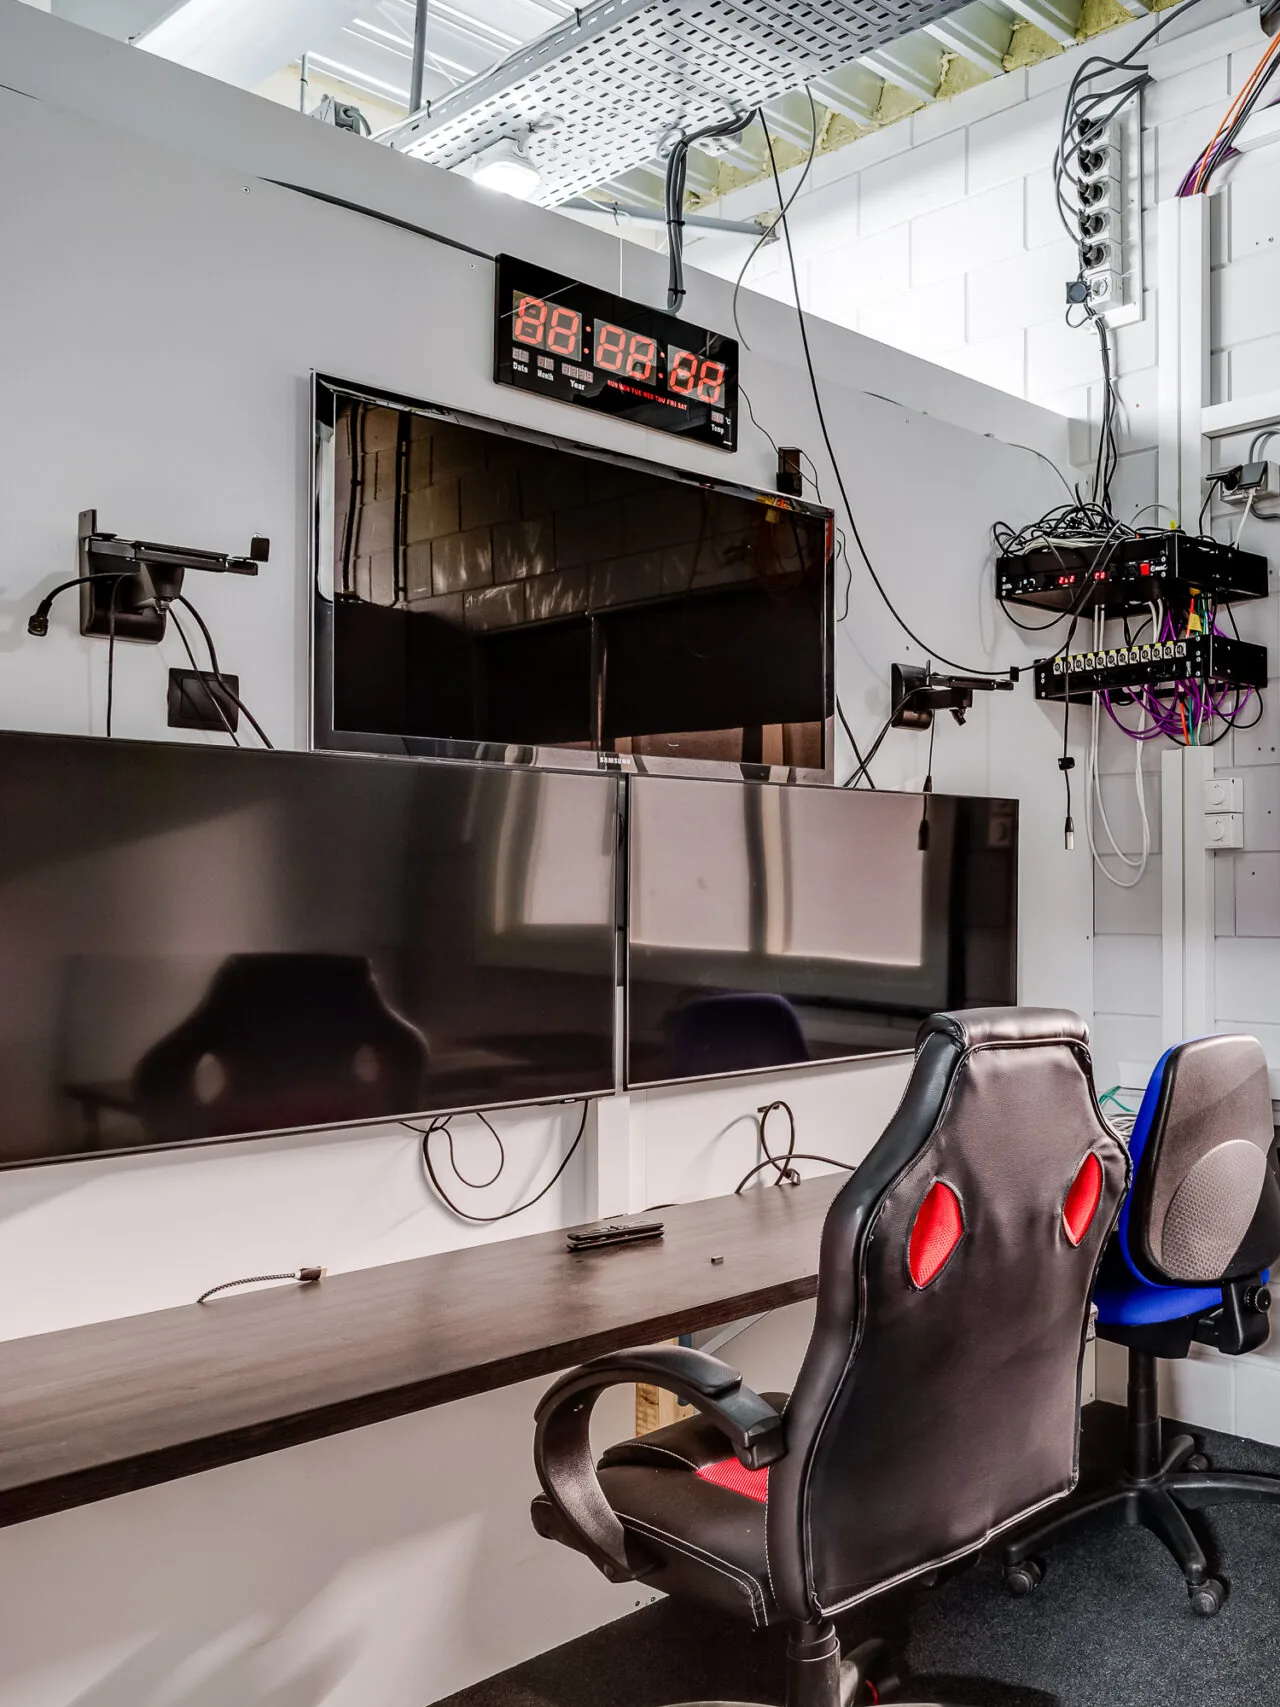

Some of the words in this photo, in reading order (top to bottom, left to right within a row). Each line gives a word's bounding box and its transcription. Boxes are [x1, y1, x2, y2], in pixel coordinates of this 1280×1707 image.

[513, 361, 529, 373] Date
[537, 369, 554, 381] Month
[570, 379, 585, 391] Year
[631, 387, 642, 397] TUE
[666, 398, 677, 408] FRI
[678, 402, 688, 411] SAT
[711, 423, 724, 436] Temp
[599, 756, 631, 765] SAMSUNG
